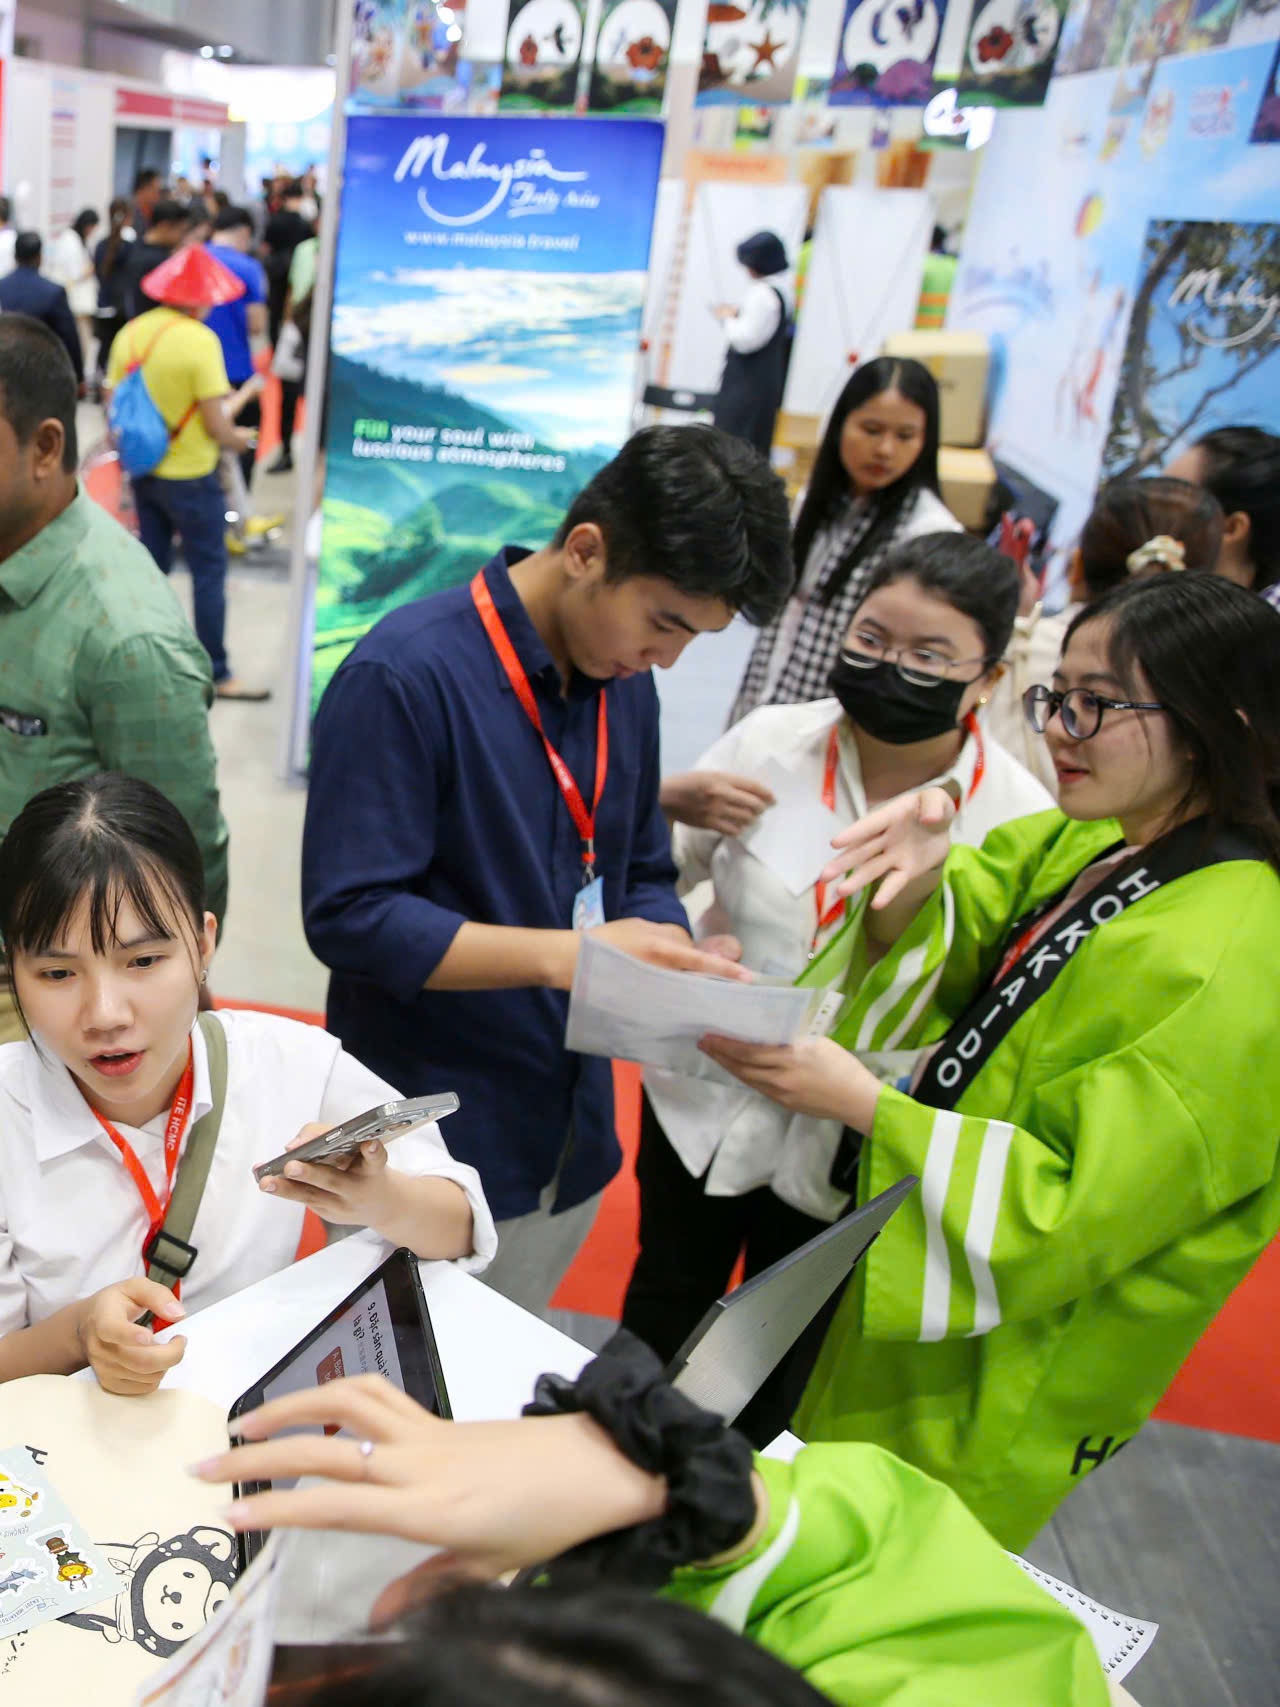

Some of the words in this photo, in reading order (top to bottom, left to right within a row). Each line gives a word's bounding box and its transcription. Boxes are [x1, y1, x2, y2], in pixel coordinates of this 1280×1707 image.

[394, 132, 588, 226] Malaysia
[403, 230, 581, 251] www.malaysia.travel
[354, 418, 389, 440] Fill
[391, 424, 437, 445] your
[440, 426, 484, 447] soul
[936, 867, 1161, 1089] HOKKAIDO
[174, 1097, 188, 1115] ITE
[167, 1116, 181, 1150] HCMC
[1070, 1436, 1130, 1475] H
